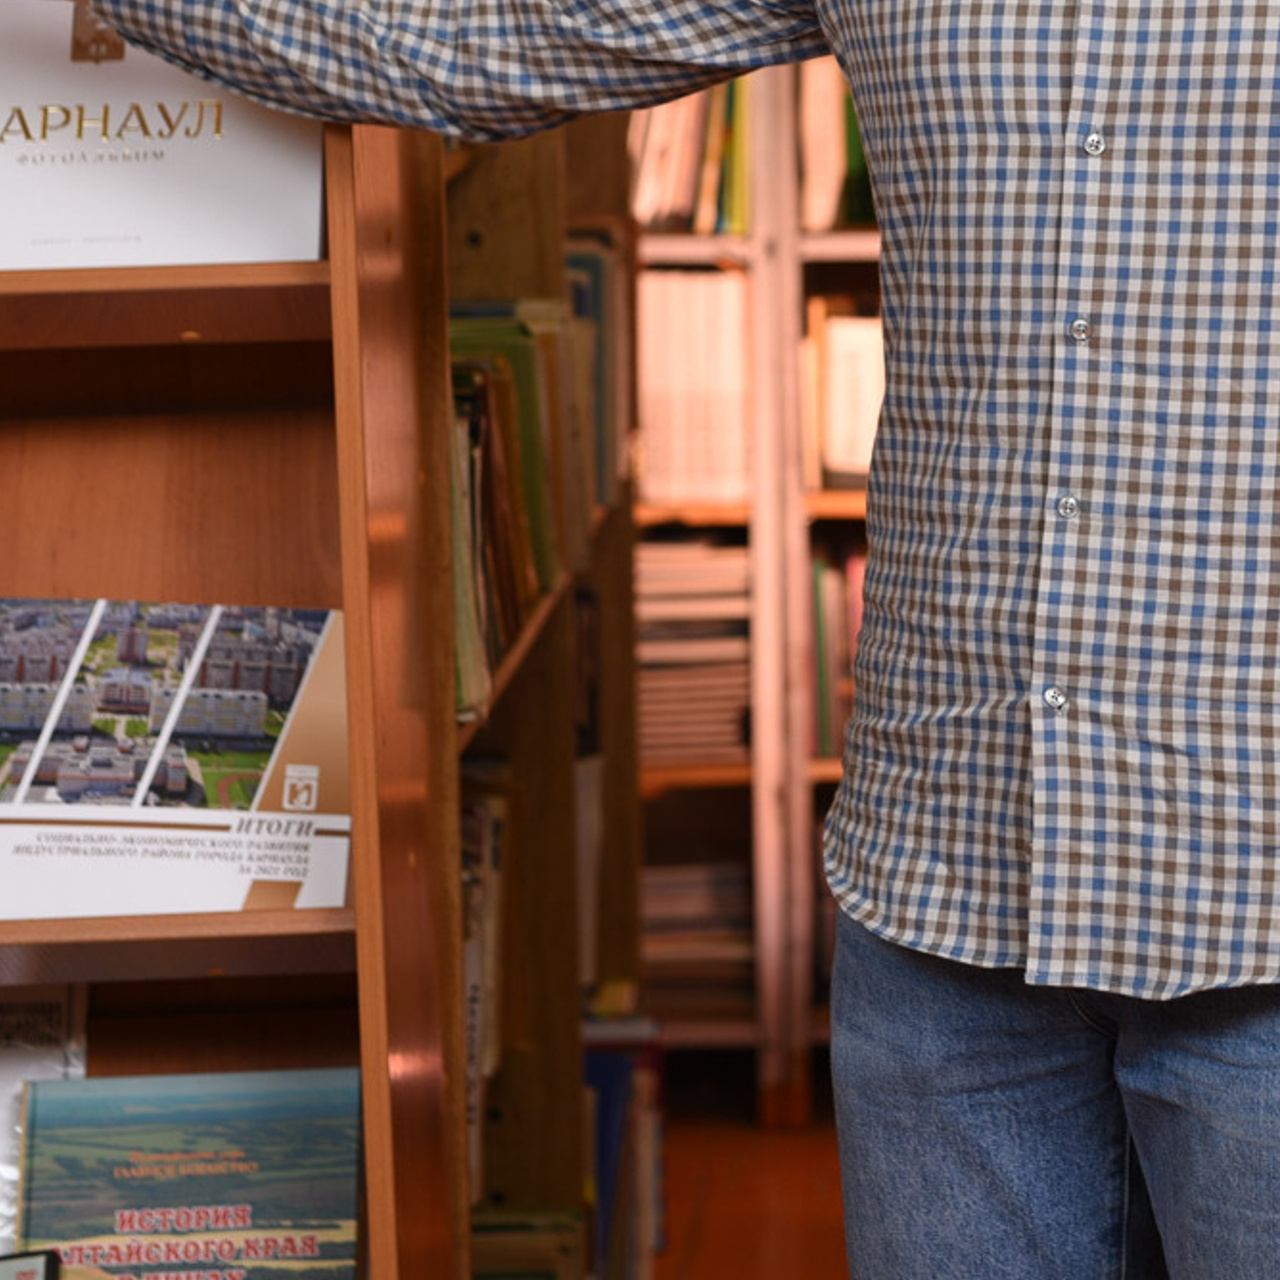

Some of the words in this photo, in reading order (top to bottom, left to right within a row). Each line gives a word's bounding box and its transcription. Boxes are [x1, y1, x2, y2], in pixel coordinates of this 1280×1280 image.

[236, 818, 314, 837] ИТОГИ
[114, 1205, 252, 1234] ИСТОРИЯ
[240, 1234, 319, 1260] КРАЯ
